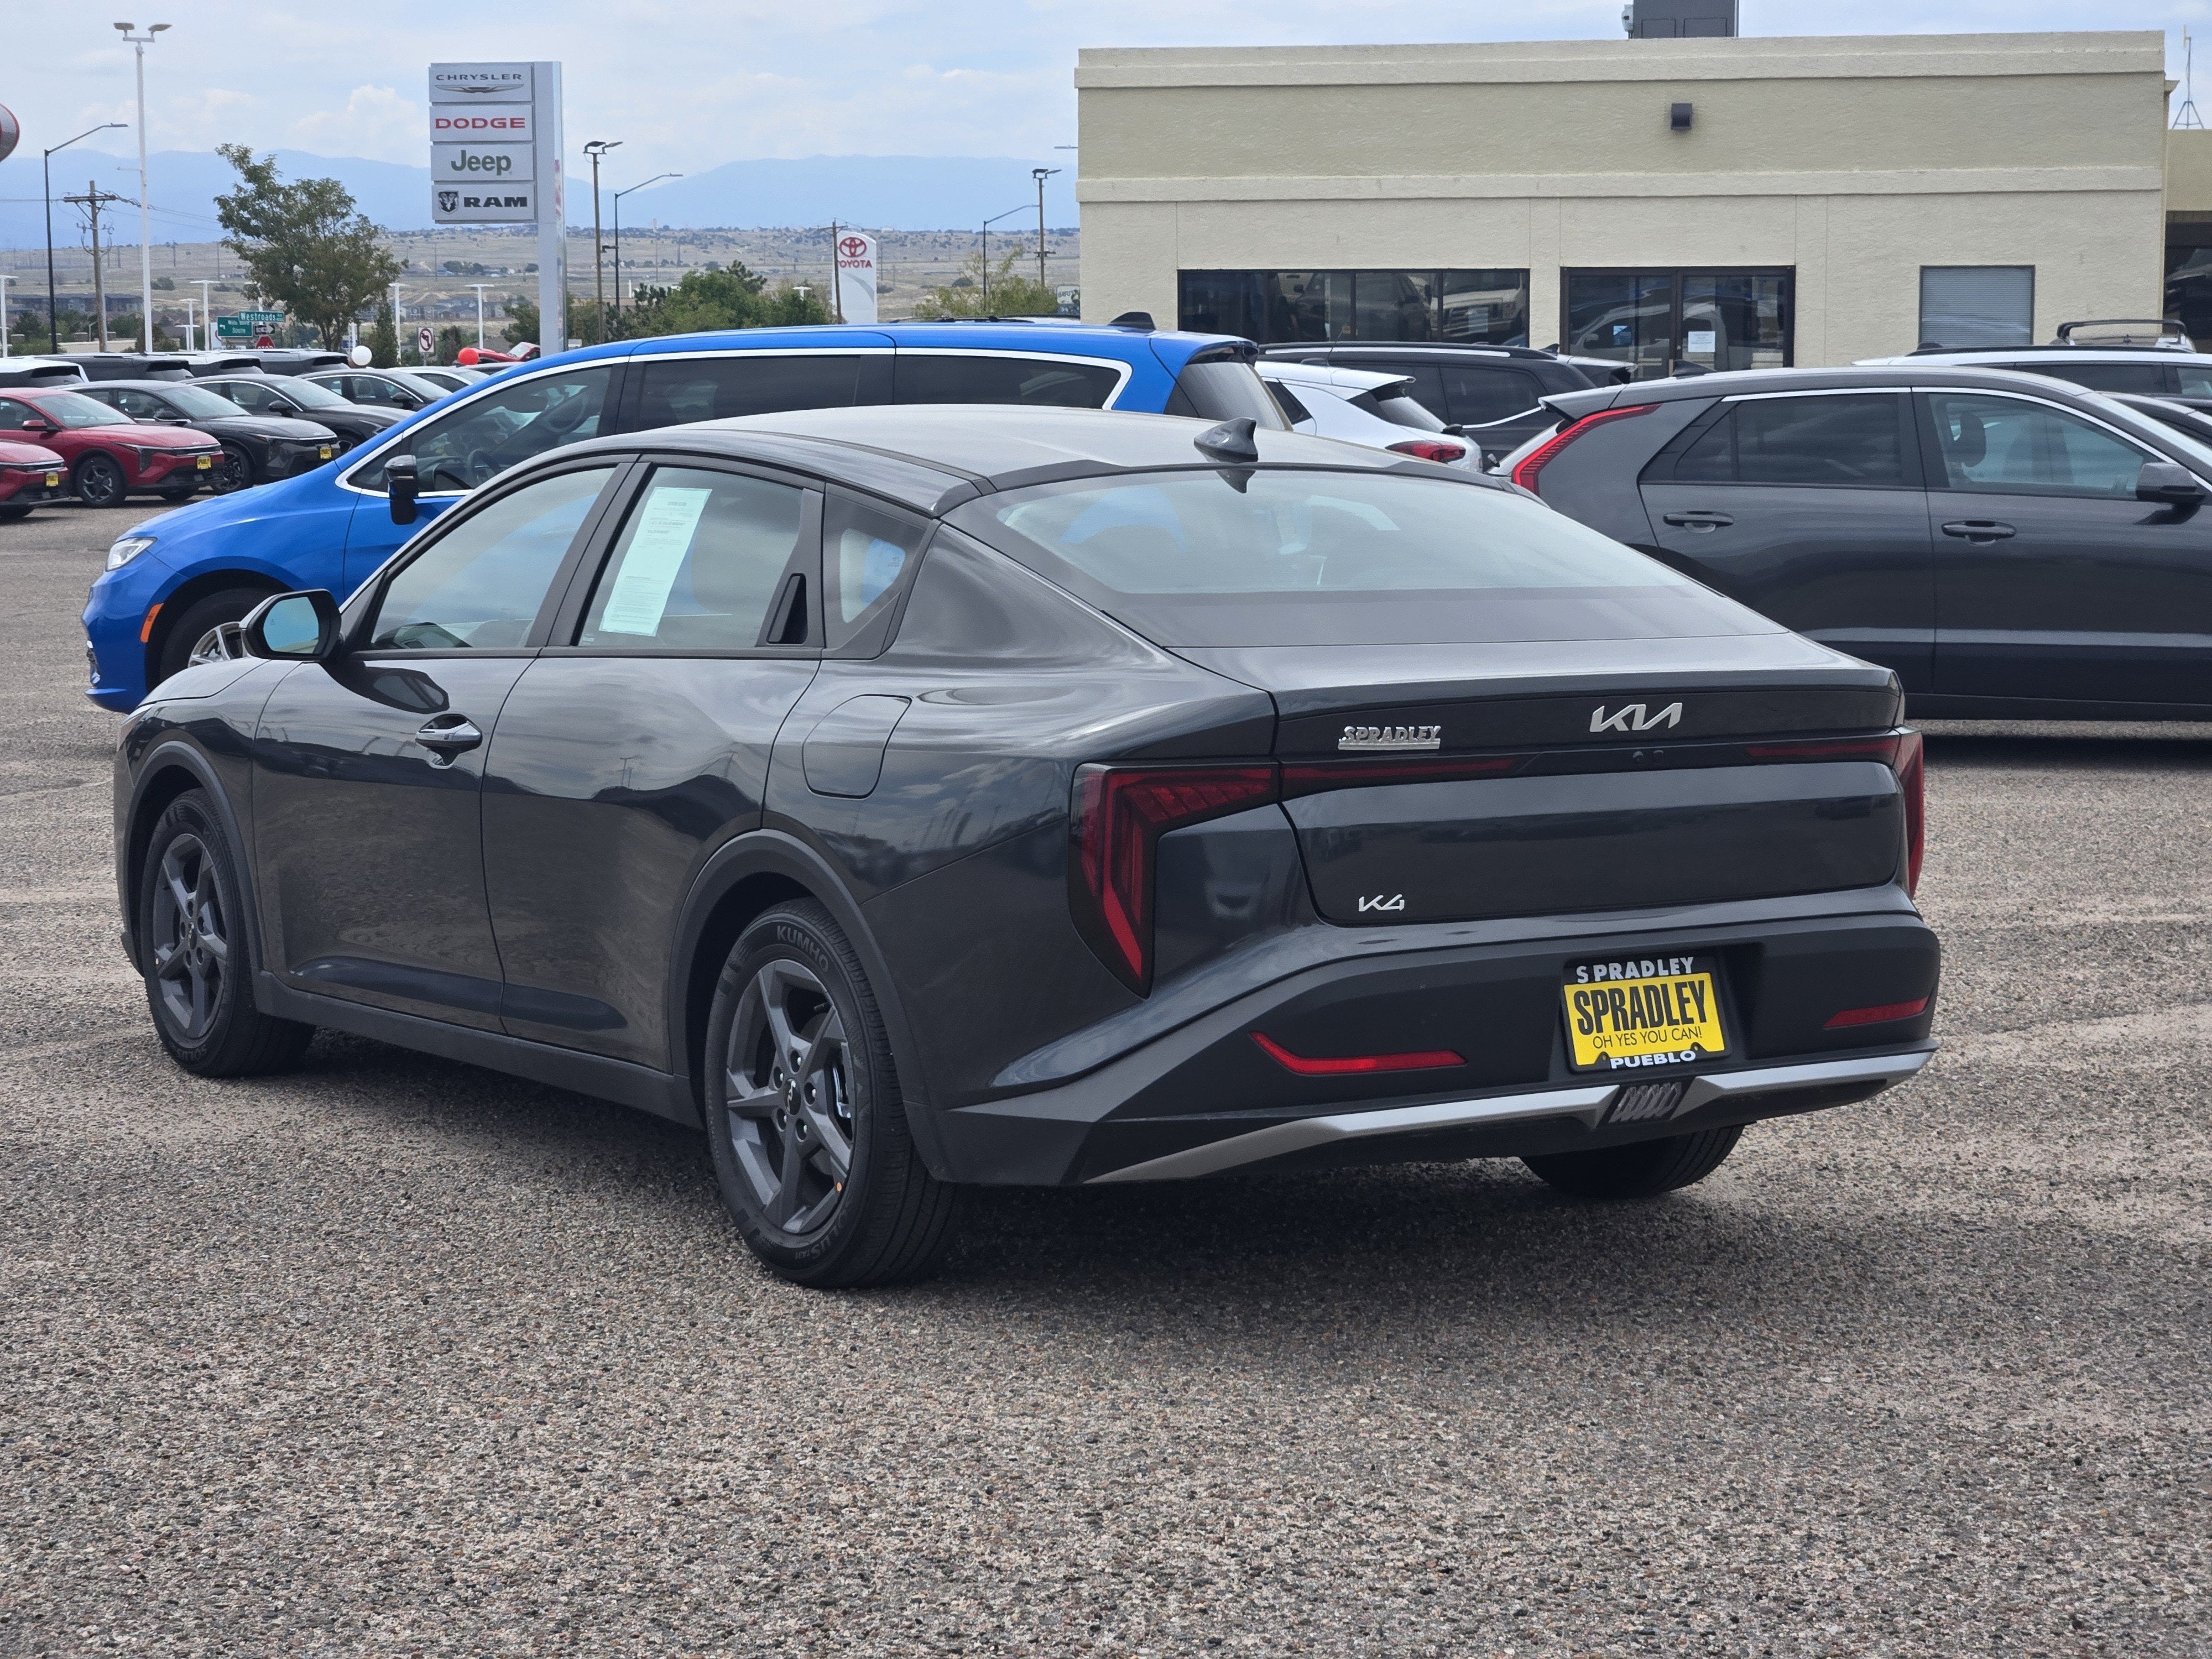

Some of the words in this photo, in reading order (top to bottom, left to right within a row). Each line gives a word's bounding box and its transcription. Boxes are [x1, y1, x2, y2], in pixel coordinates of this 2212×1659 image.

[435, 118, 525, 129] DODGE
[451, 150, 512, 175] Jeep
[463, 197, 528, 207] RAM
[838, 260, 873, 268] OYOTA
[241, 312, 276, 321] Westroads
[1344, 726, 1441, 743] SPRADLEY
[1358, 894, 1405, 912] K4
[776, 925, 829, 972] KUMHO
[1576, 957, 1694, 984] SPRADLEY
[1573, 980, 1707, 1036] SPRADLEY
[1593, 1036, 1613, 1049] OH
[1615, 1032, 1637, 1046] YES
[1640, 1030, 1667, 1044] YOU
[1672, 1026, 1702, 1041] CAN!
[1610, 1050, 1696, 1069] PUEBLO
